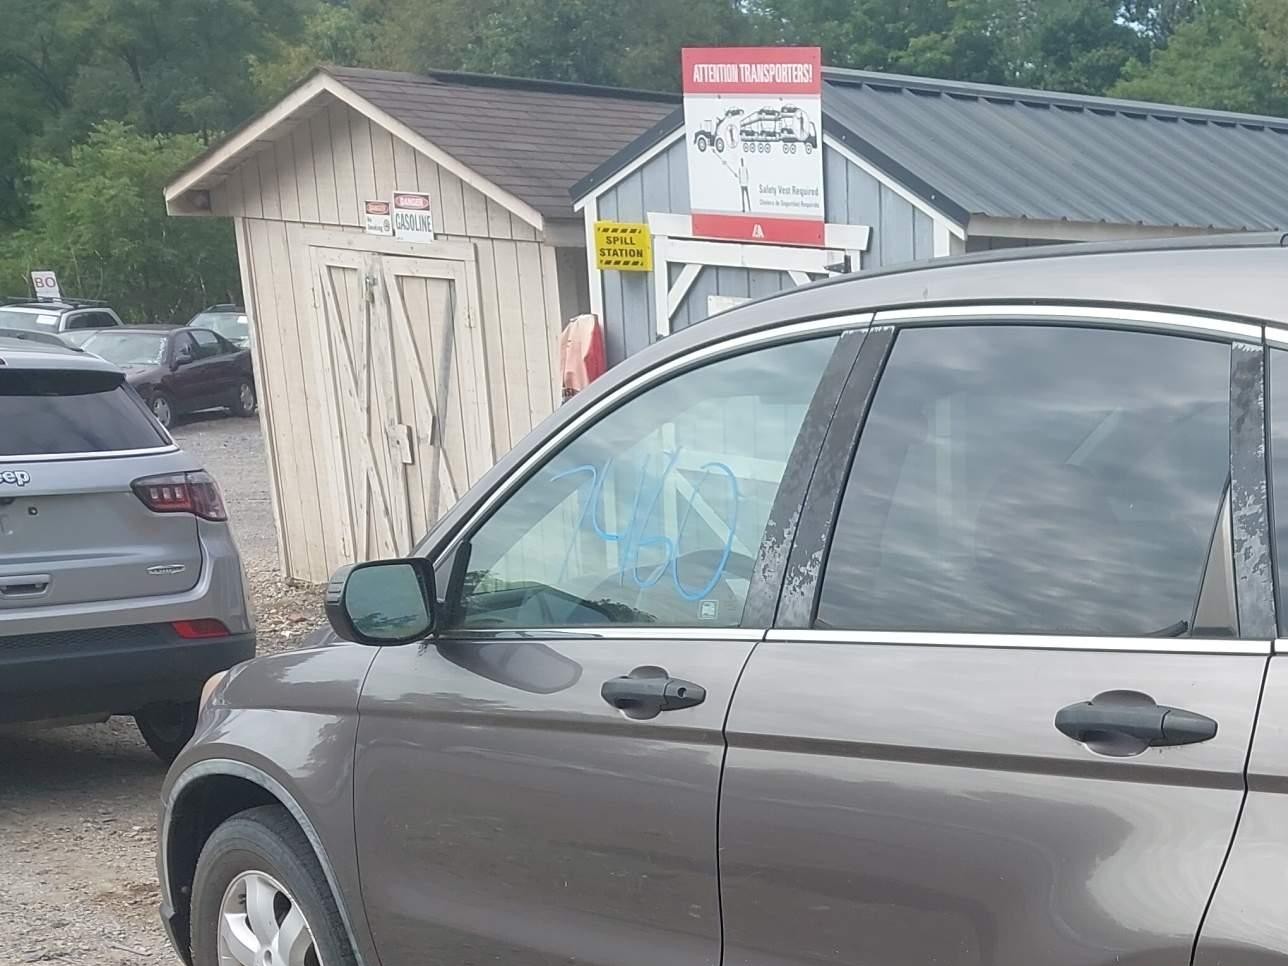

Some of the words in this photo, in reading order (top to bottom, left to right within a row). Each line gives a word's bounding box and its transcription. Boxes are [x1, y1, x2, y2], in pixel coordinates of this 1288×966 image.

[693, 63, 738, 83] ATTENTION
[739, 63, 813, 83] TRANSPORTERS!
[396, 213, 432, 232] GASOLINE
[606, 236, 636, 245] SPILL
[599, 248, 643, 257] STATION
